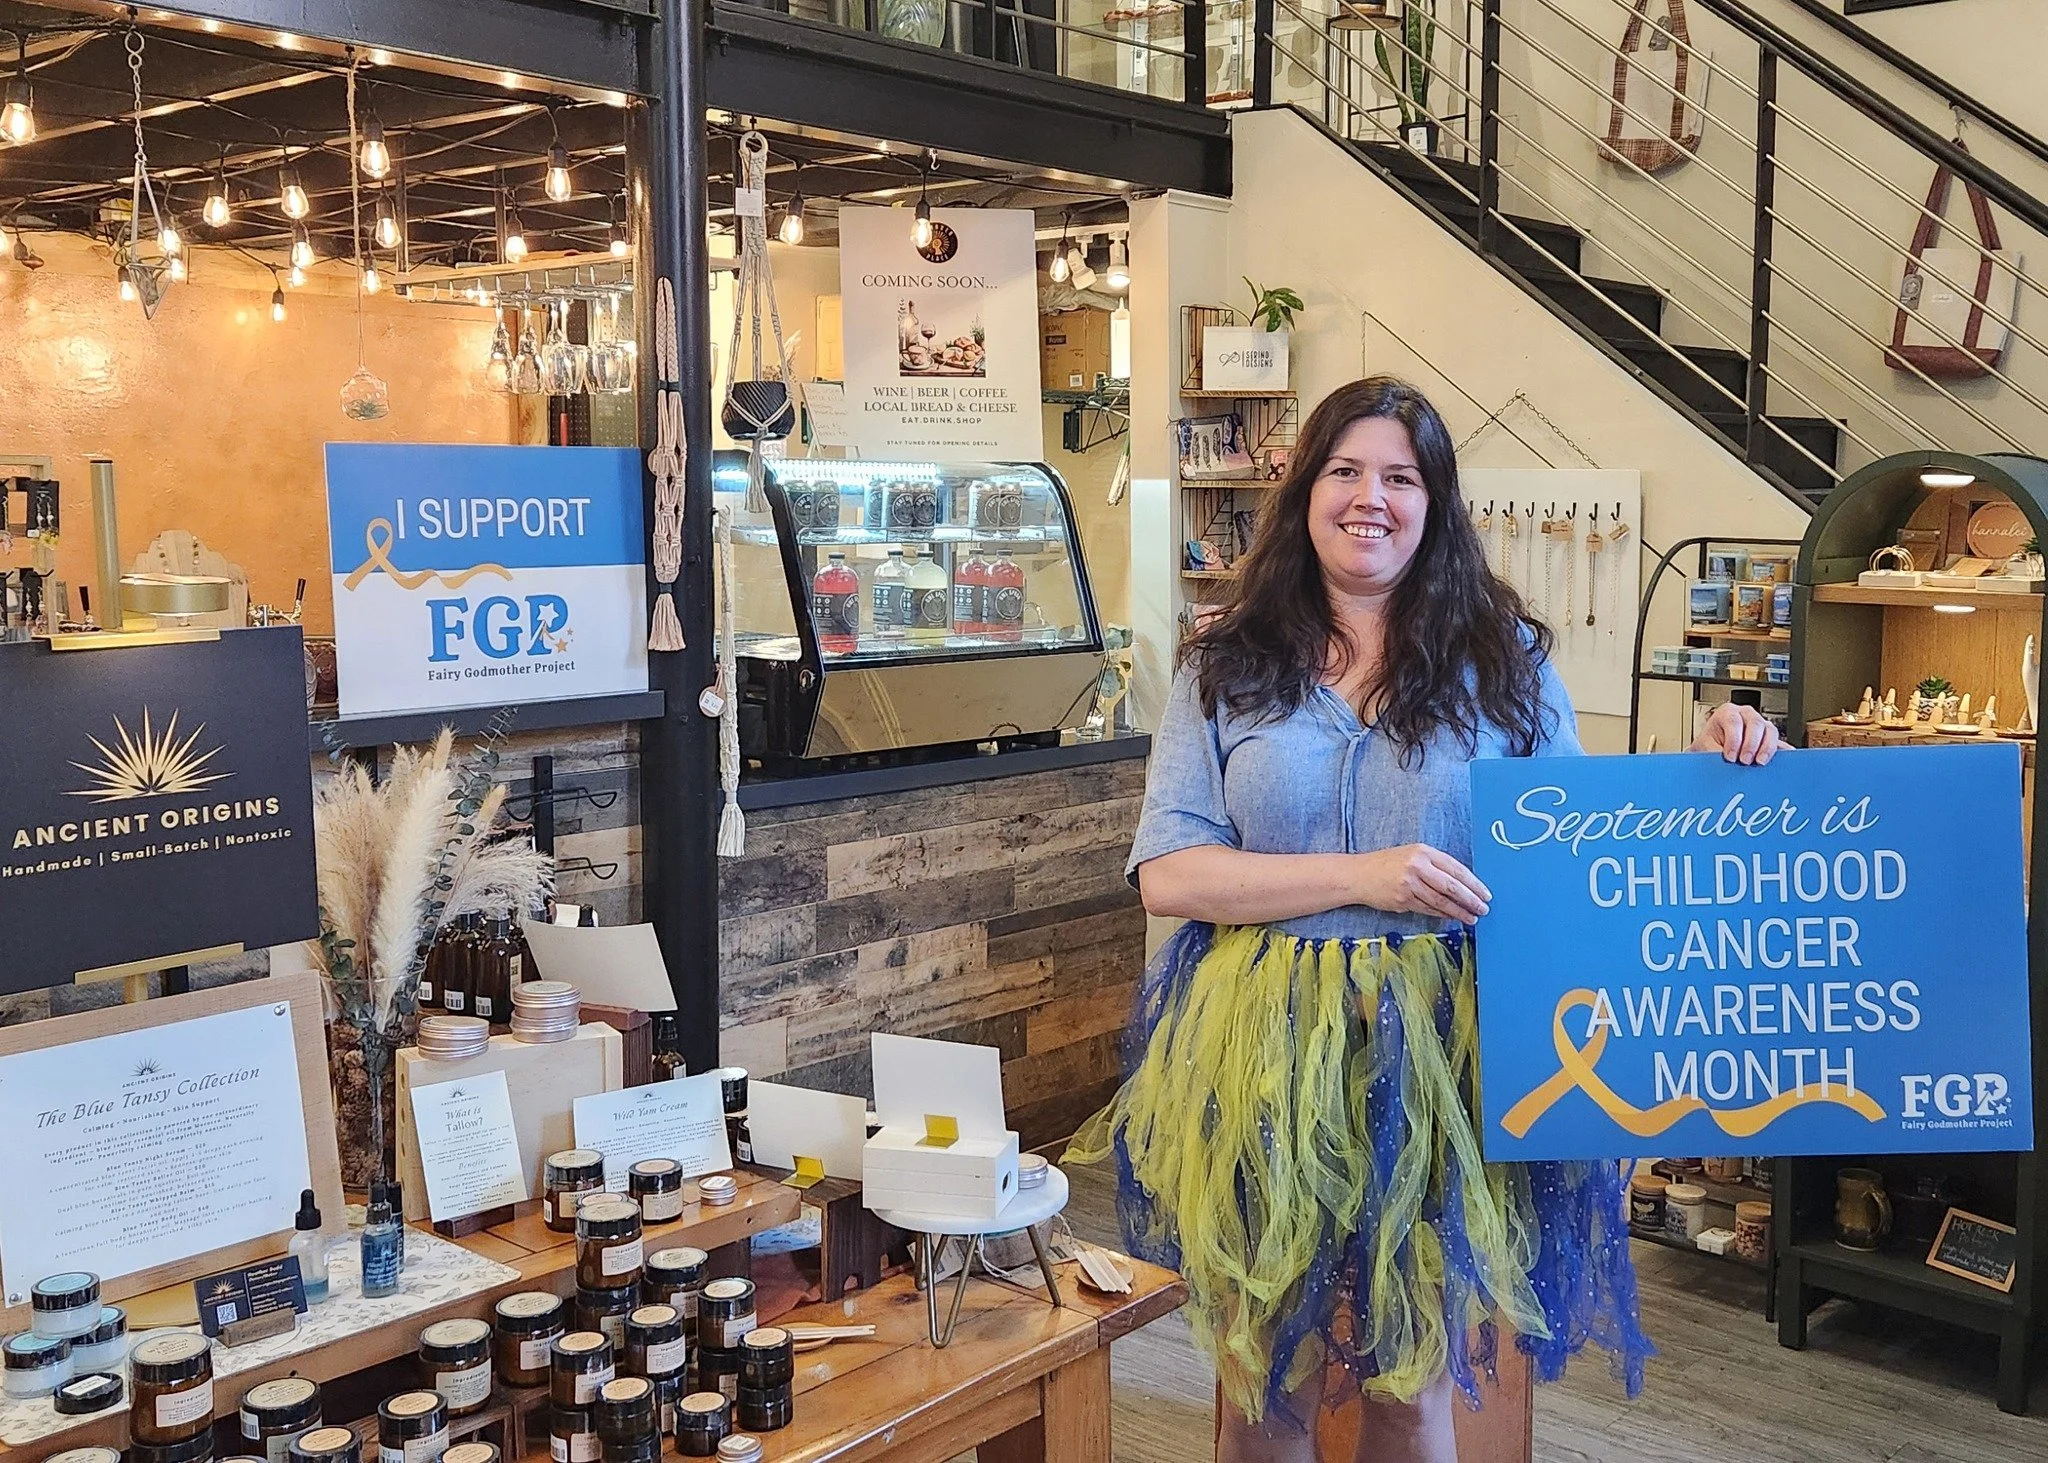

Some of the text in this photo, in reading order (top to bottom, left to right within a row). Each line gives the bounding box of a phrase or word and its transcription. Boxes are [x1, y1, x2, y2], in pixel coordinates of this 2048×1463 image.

[862, 274, 998, 290] COMING SOON...
[1246, 359, 1274, 368] DESIGNS
[864, 402, 1018, 413] LOCAL BREAD & CHEESE
[873, 387, 908, 397] WINE
[917, 387, 949, 398] BEER
[959, 388, 1008, 398] COFFEE
[396, 497, 591, 540] I SUPPORT
[425, 593, 569, 663] FGP
[428, 660, 576, 682] Fairy Godmother Project
[12, 797, 280, 849] ANCIENT ORIGINS
[1491, 785, 1880, 857] September is
[2, 855, 92, 878] Handmade
[110, 838, 209, 862] Small-Batch
[225, 828, 293, 847] Nontoxic
[1588, 849, 1907, 908] CHILDHOOD
[1640, 916, 1863, 973] CANCER
[1584, 980, 1922, 1039] AWARENESS
[1653, 1046, 1856, 1102] MONTH
[1901, 1072, 2010, 1118] FGP
[37, 1067, 261, 1129] The Blue Tansy Collection
[445, 1106, 482, 1120] What is
[612, 1102, 688, 1122] Wild Yam Cream
[445, 1117, 484, 1132] Tallow?
[1901, 1117, 2013, 1131] Fairy Godmother Project
